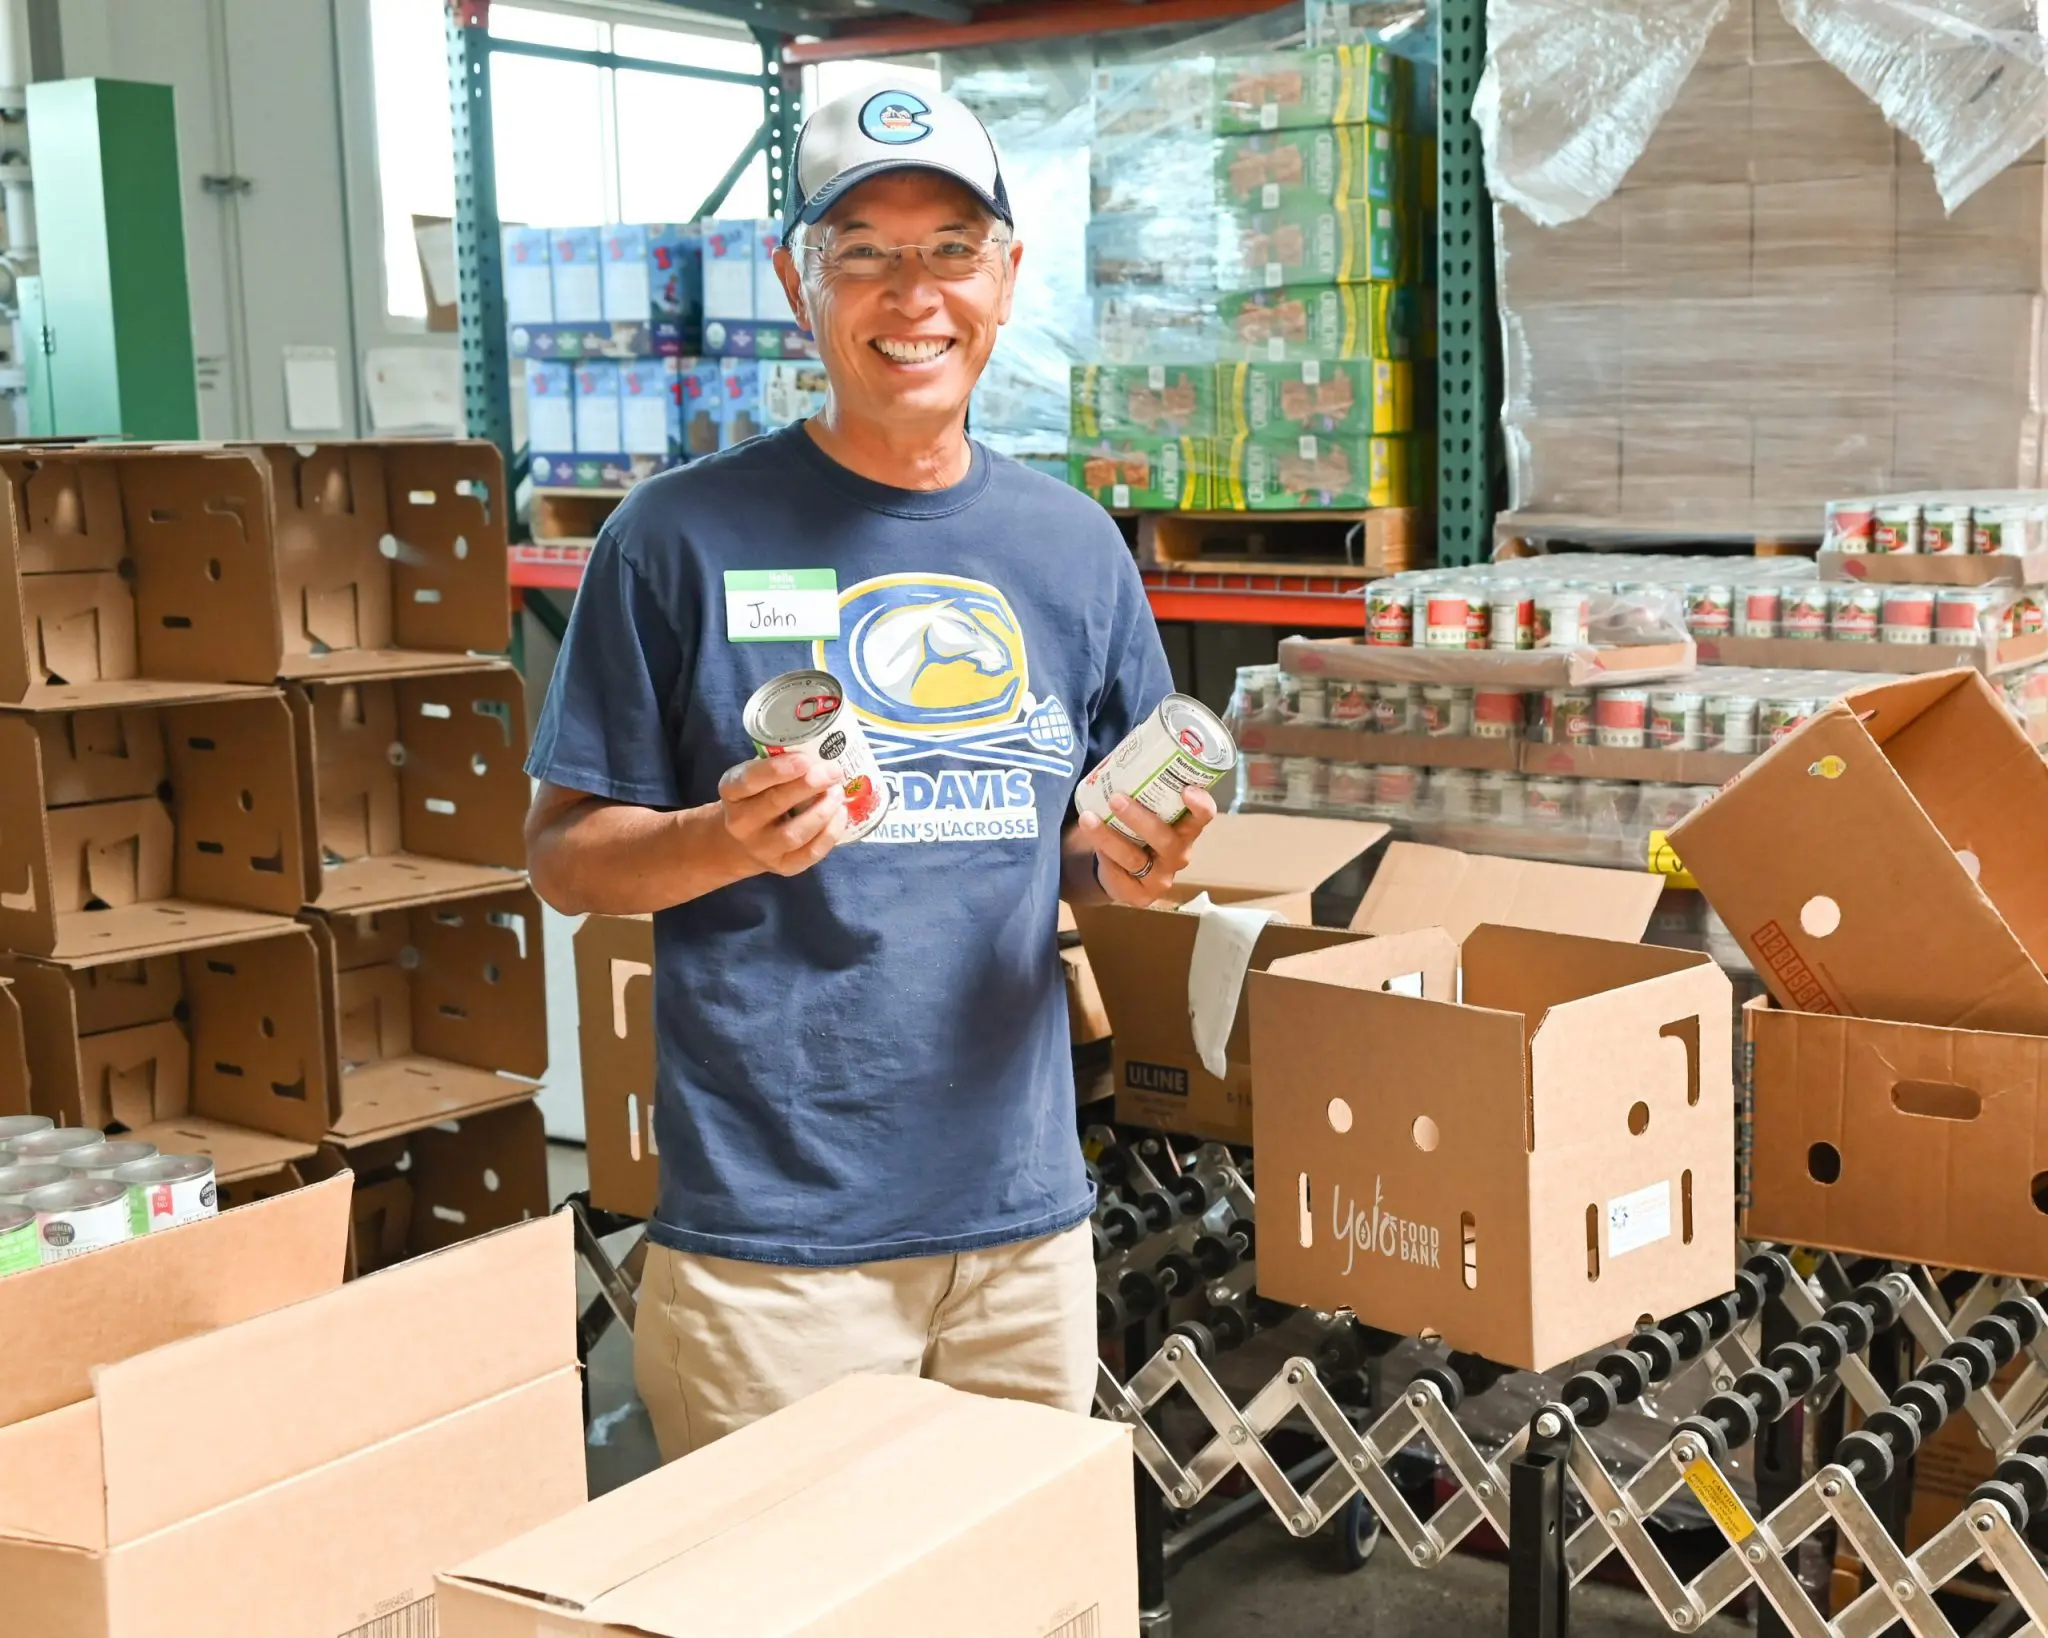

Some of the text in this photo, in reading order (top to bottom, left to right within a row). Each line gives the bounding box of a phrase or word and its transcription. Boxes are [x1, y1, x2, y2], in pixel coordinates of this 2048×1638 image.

[747, 601, 797, 629] John
[1175, 756, 1200, 775] Nutrition
[873, 818, 1036, 839] MEN'S LACROSSE
[1128, 1064, 1186, 1092] ULINE
[1400, 1220, 1439, 1249] FOOD
[1400, 1240, 1441, 1270] BANK
